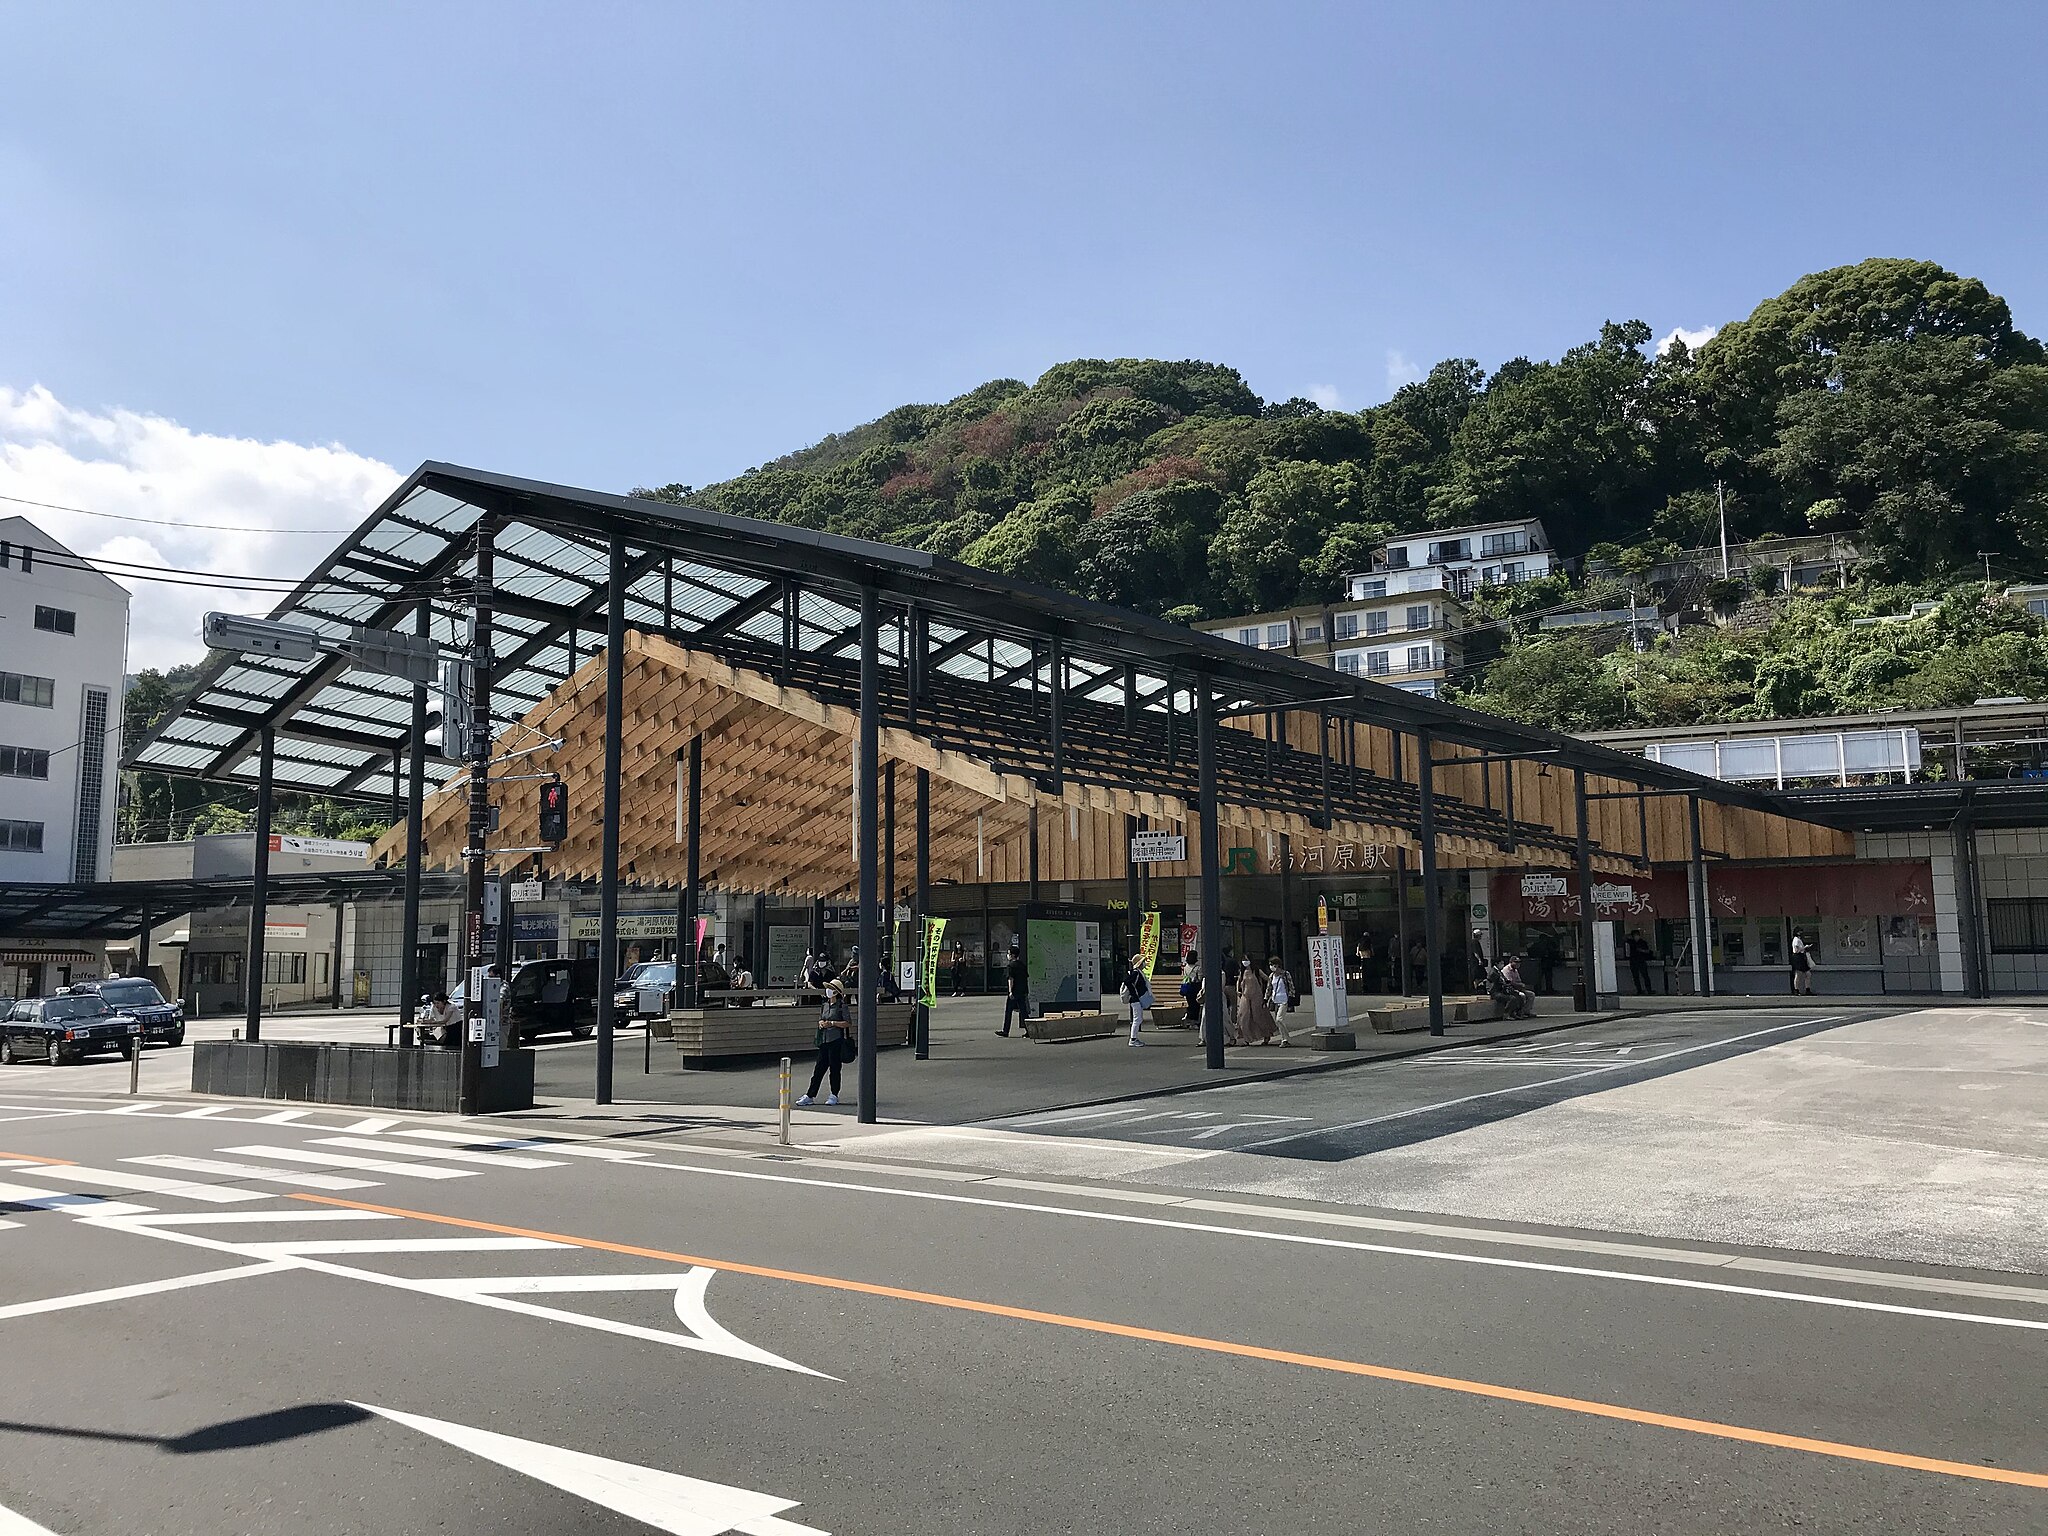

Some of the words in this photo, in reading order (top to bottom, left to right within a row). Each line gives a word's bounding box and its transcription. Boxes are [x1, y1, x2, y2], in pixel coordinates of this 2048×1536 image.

[1220, 847, 1259, 875] JR
[1557, 879, 1565, 894] 2
[1331, 895, 1343, 903] JR
[1312, 940, 1324, 987] バス降車場
[72, 971, 97, 979] coffee
